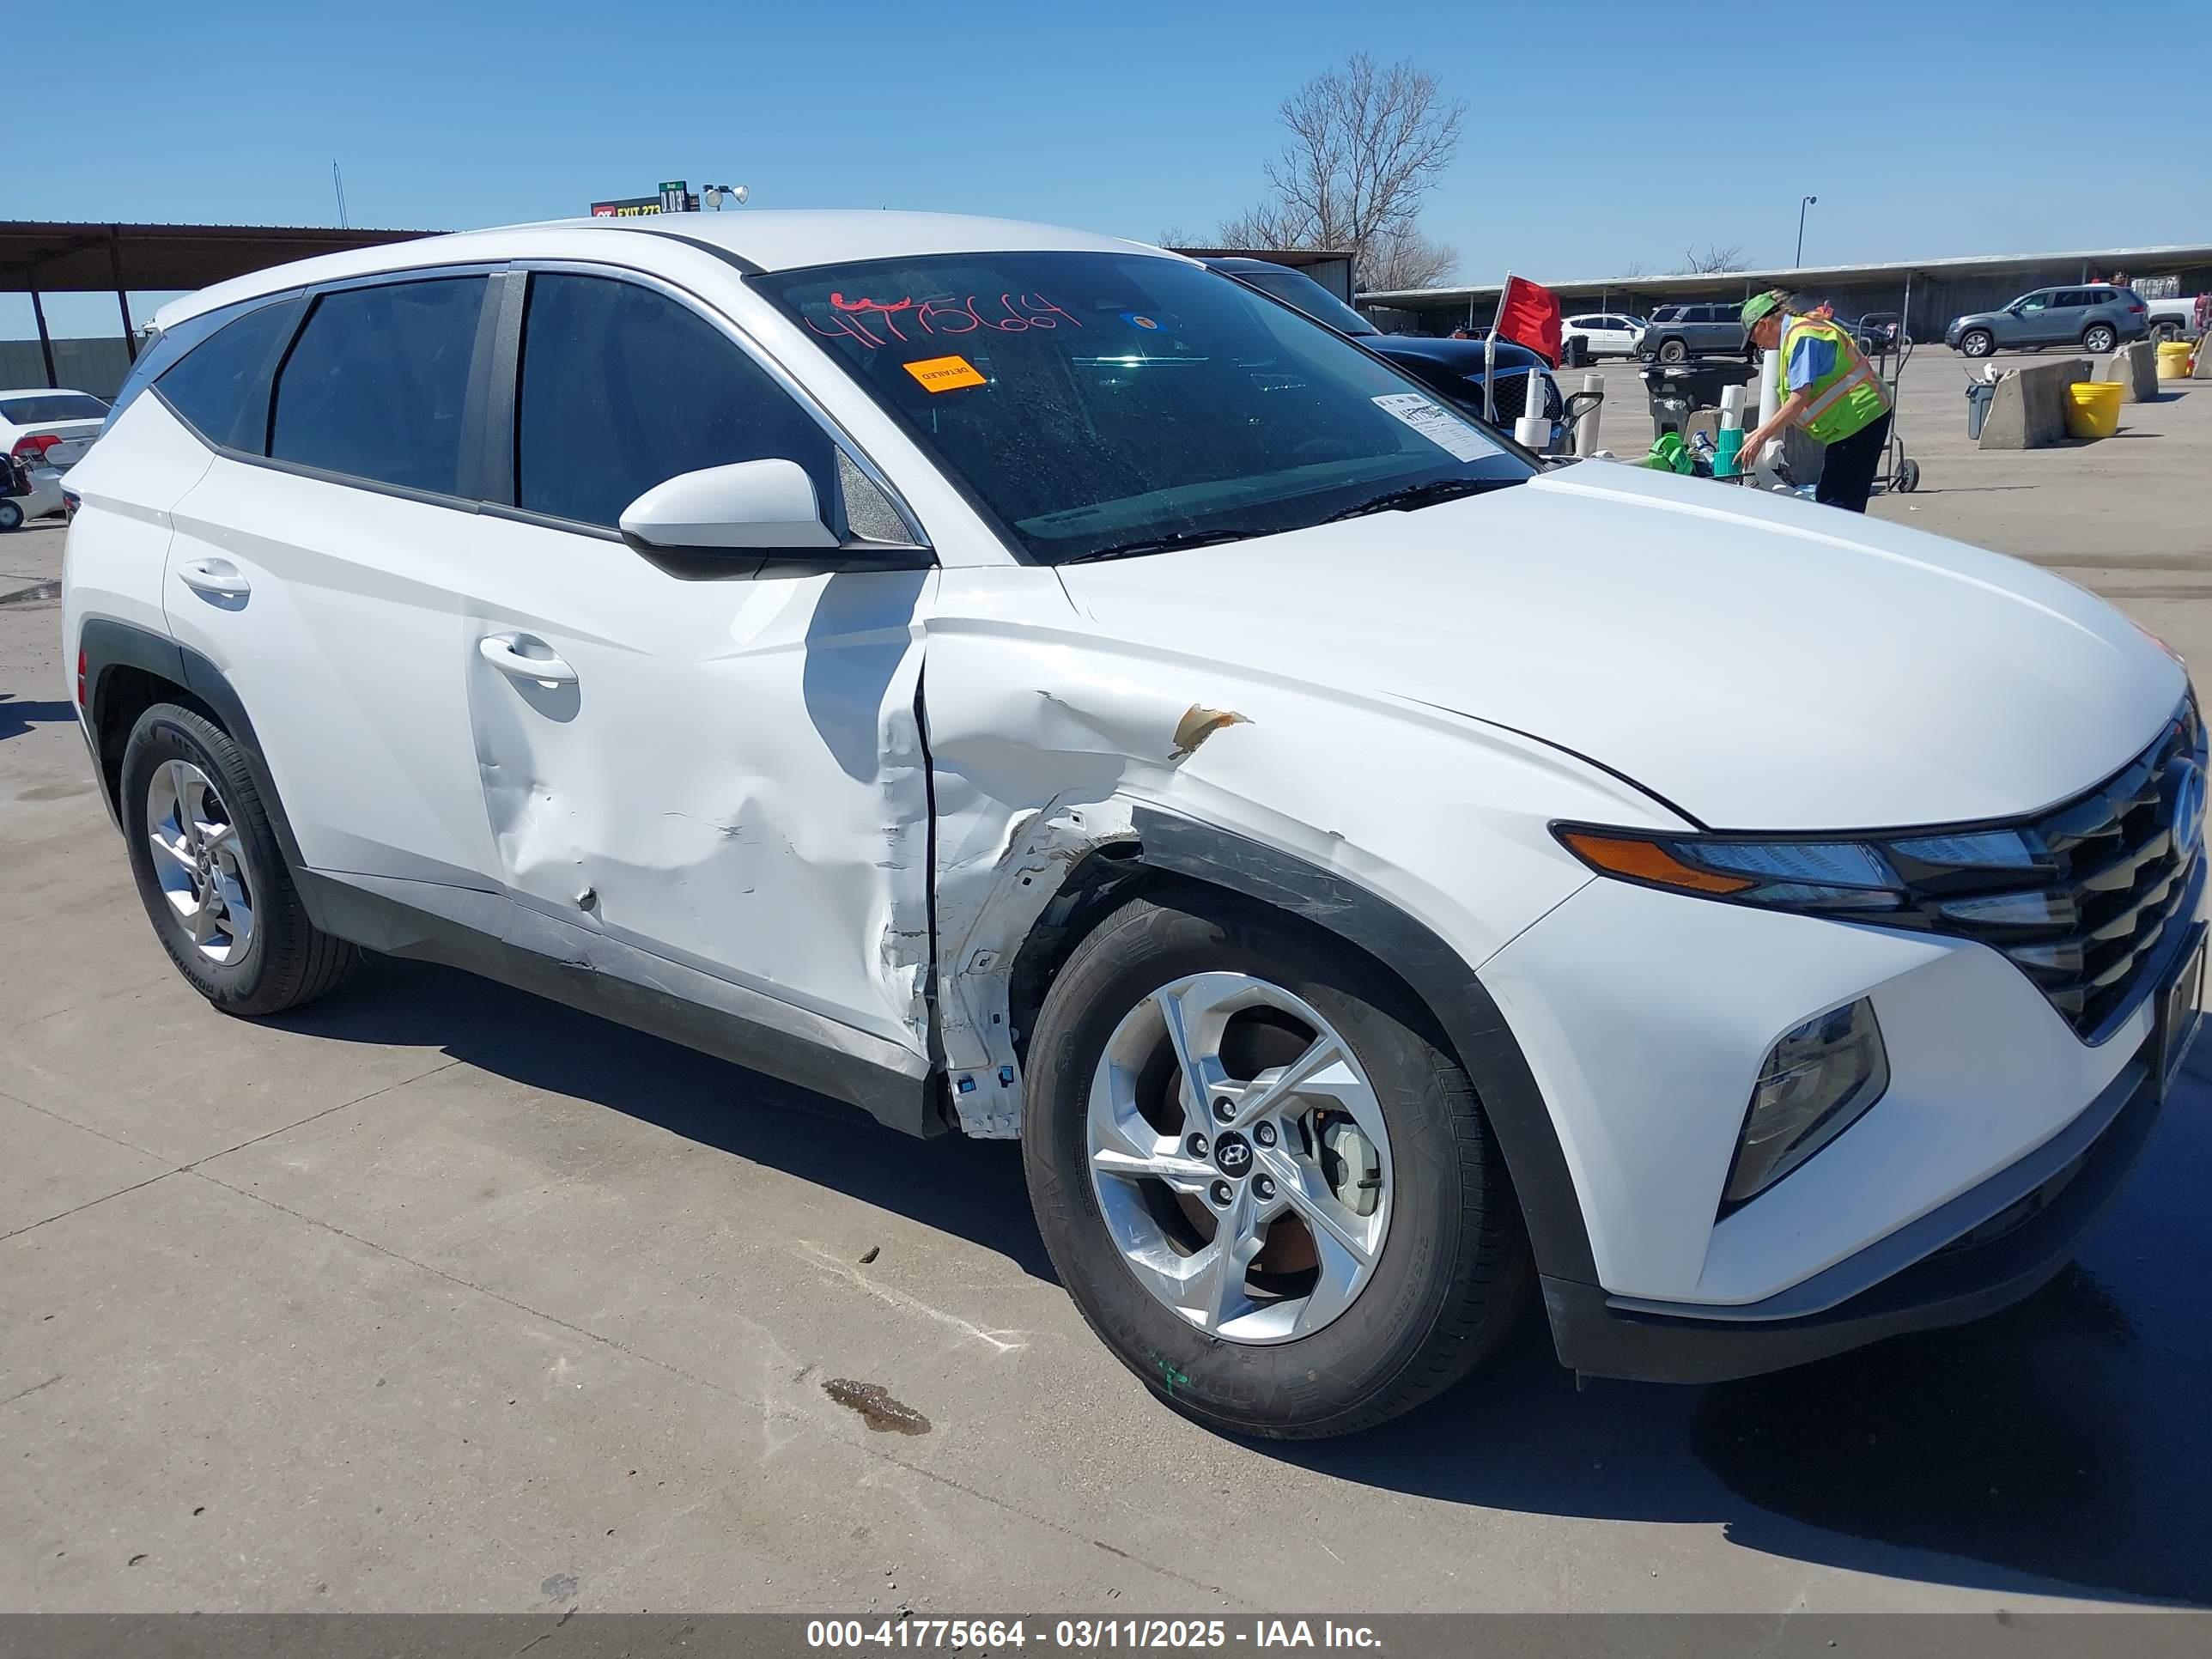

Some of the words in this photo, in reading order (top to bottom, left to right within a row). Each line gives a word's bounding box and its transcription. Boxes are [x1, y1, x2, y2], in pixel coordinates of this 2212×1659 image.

[617, 206, 640, 216] EXIT
[641, 204, 661, 216] 273
[921, 367, 969, 380] DETAILED
